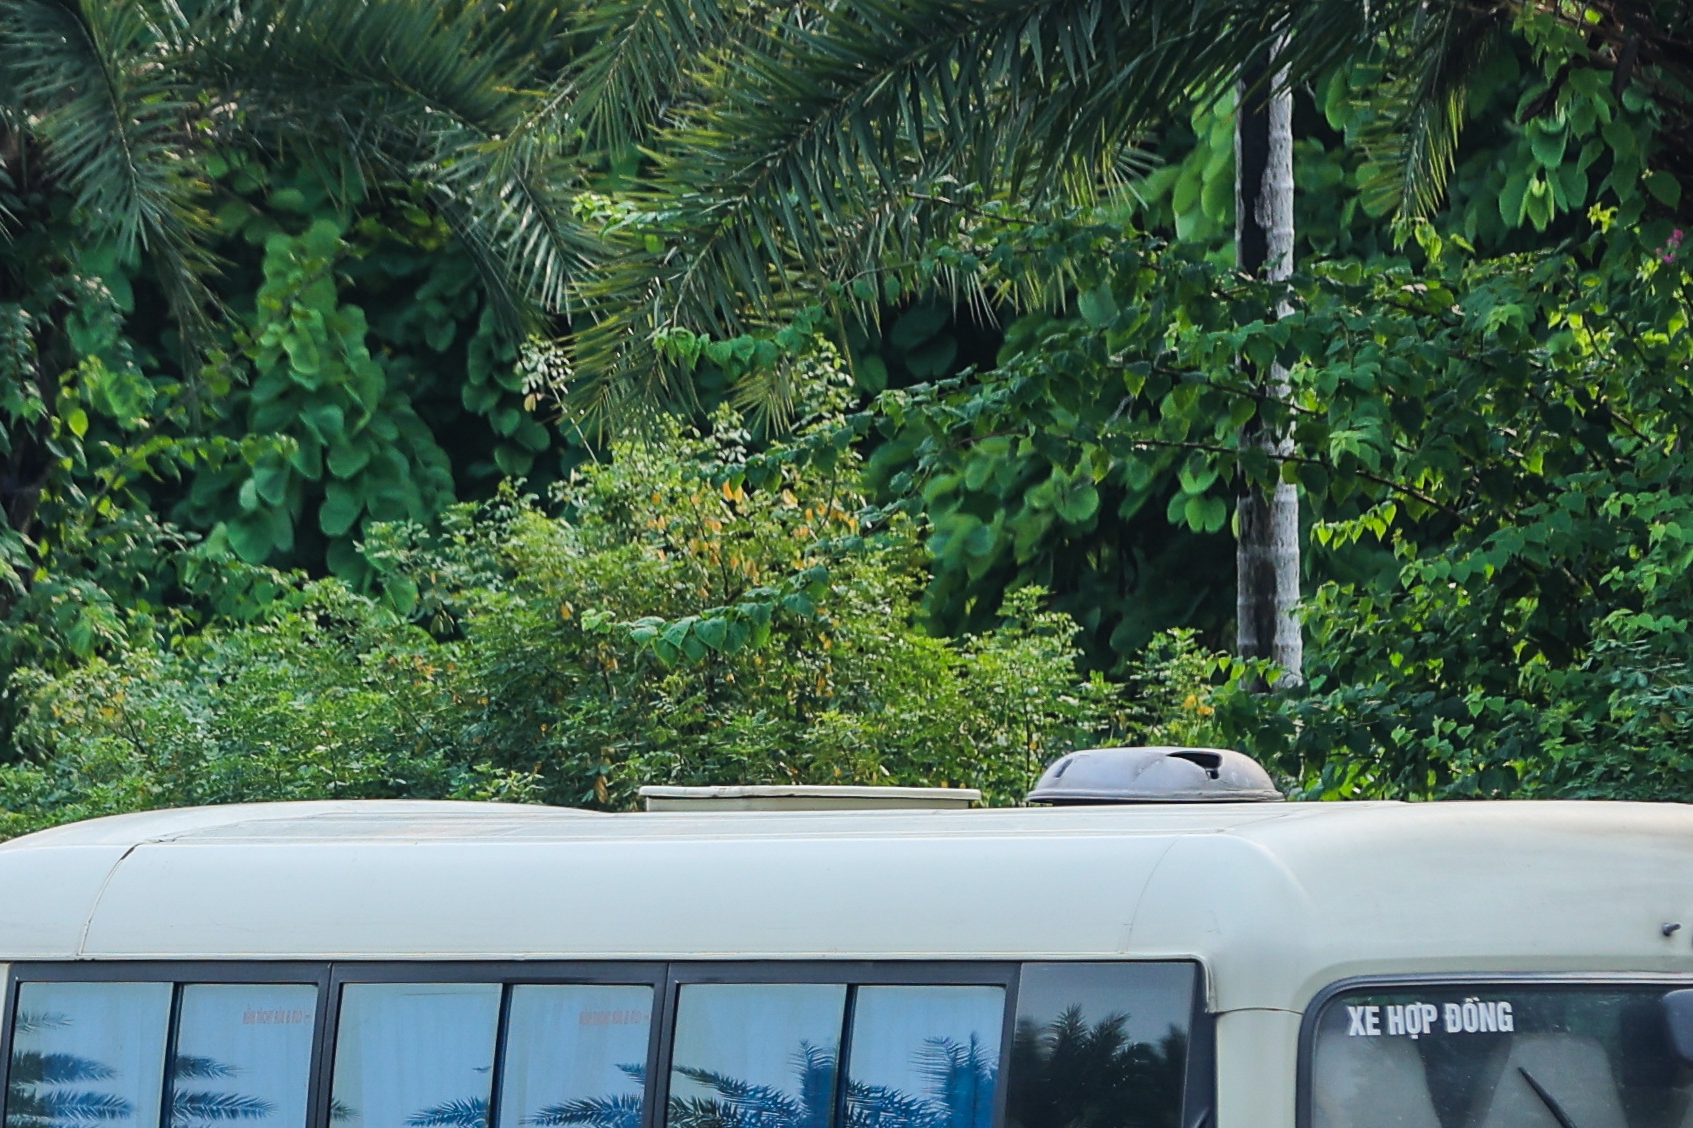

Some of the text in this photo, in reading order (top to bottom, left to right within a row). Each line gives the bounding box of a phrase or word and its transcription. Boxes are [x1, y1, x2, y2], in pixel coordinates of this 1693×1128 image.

[1348, 996, 1514, 1040] XE HỢP ĐỒNG
